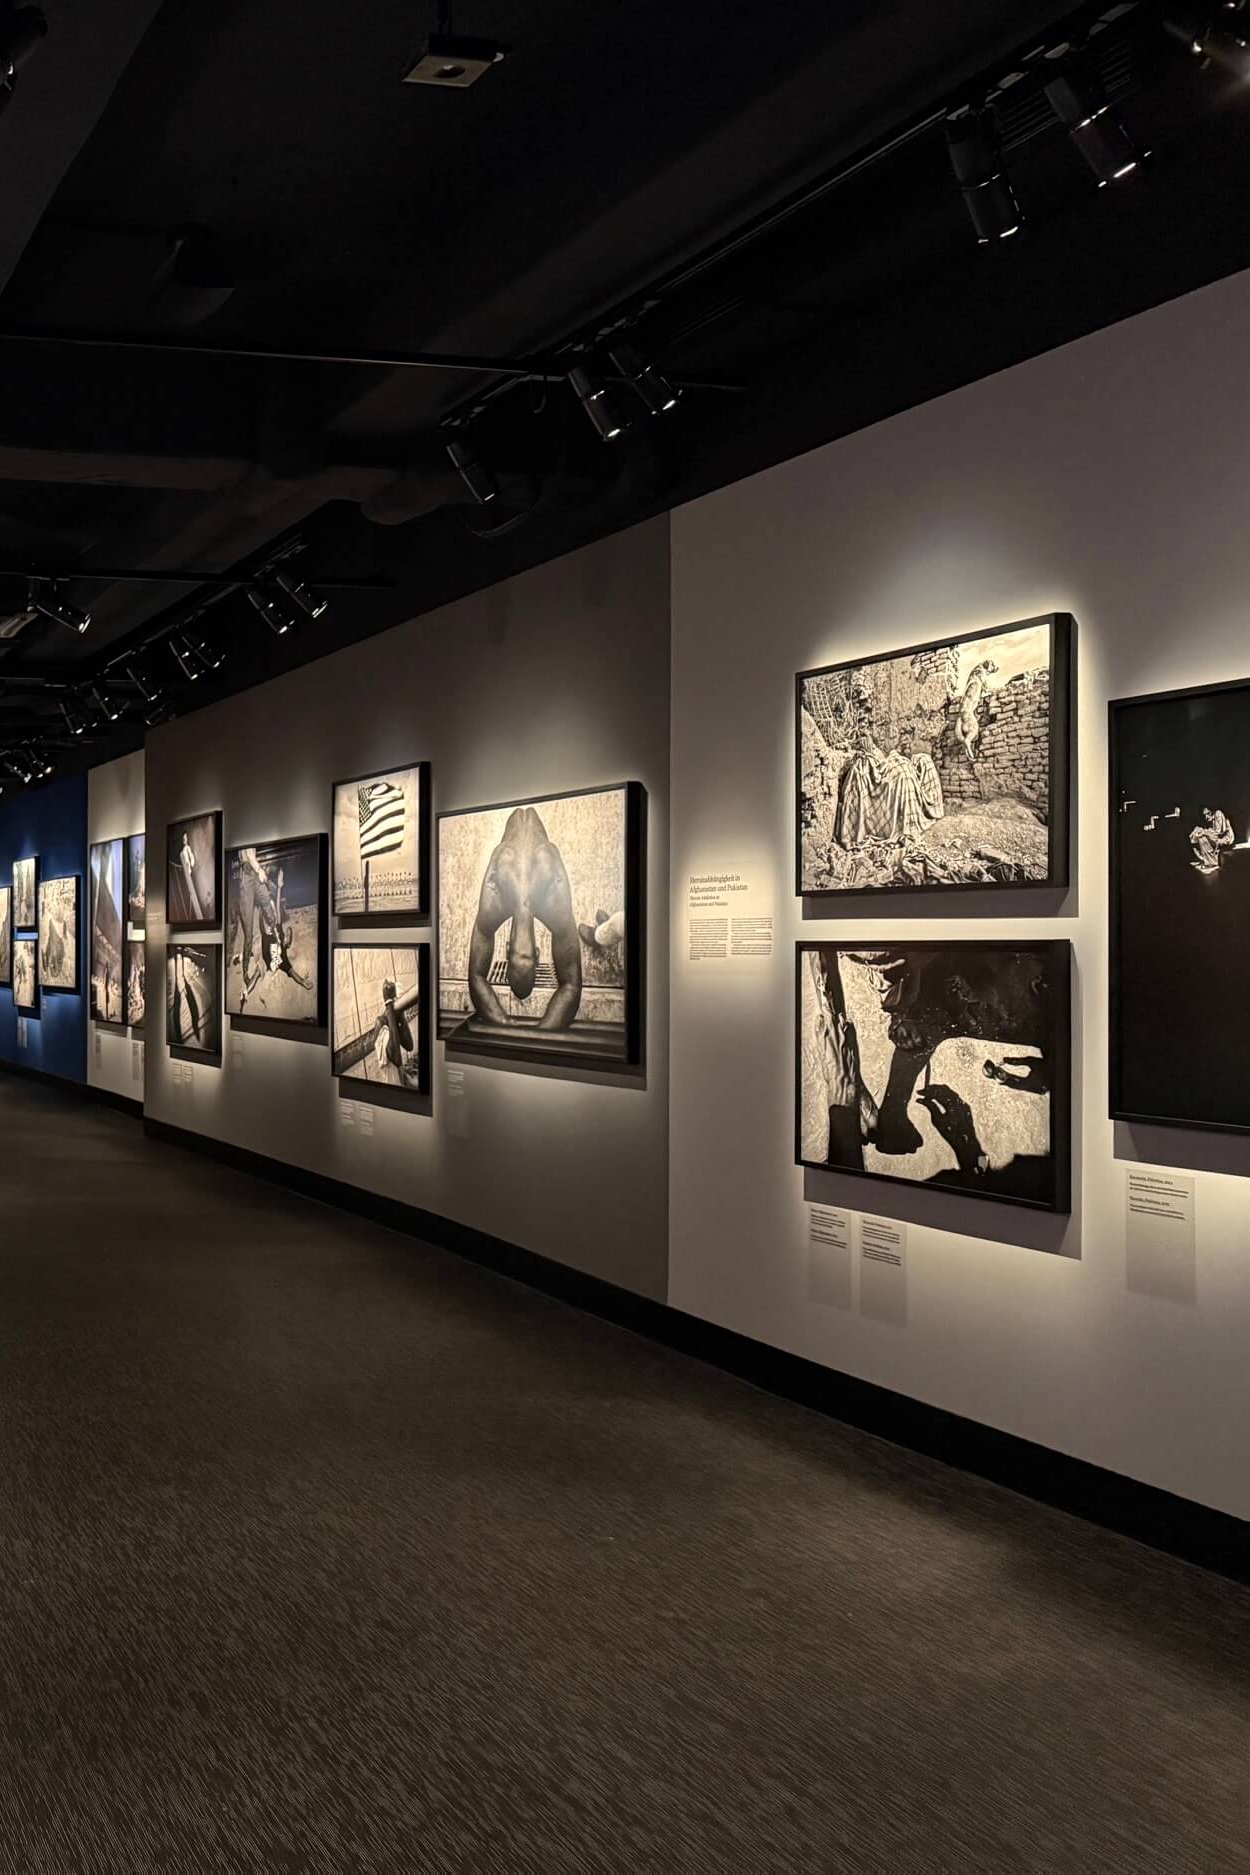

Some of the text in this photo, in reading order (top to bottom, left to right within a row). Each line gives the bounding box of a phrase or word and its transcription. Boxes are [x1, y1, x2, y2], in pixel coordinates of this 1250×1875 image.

[690, 883, 748, 894] Afghanistan und Pakistan
